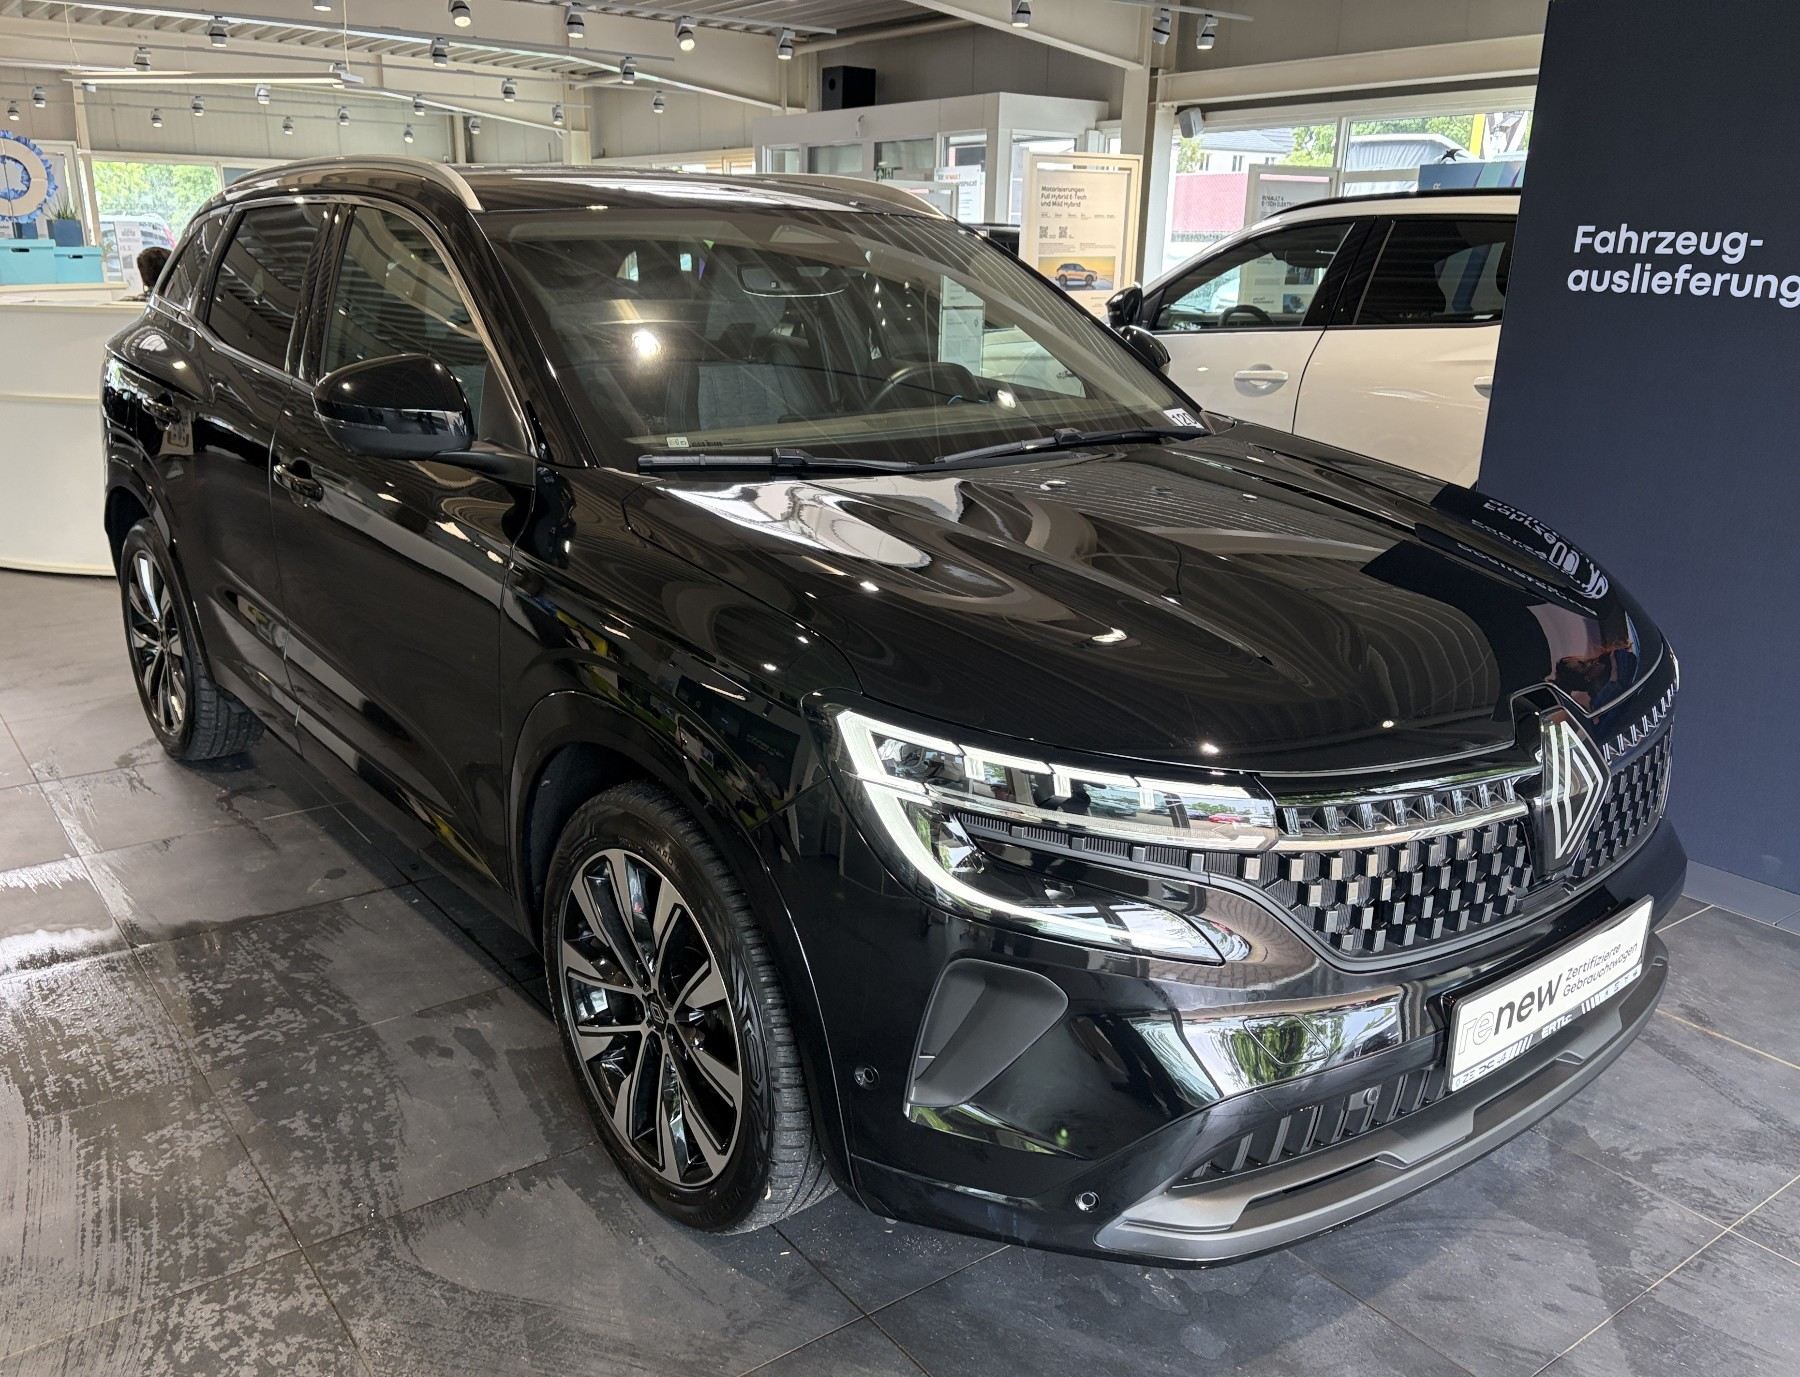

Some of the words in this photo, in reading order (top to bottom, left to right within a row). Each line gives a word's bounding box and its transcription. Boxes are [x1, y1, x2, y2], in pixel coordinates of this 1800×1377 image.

[1573, 223, 1764, 265] Fahrzeug-
[1567, 262, 1800, 309] auslieferung
[1563, 943, 1638, 997] Gebrauchtwagen
[1566, 943, 1622, 981] Zertifizierte
[1458, 972, 1563, 1056] renew
